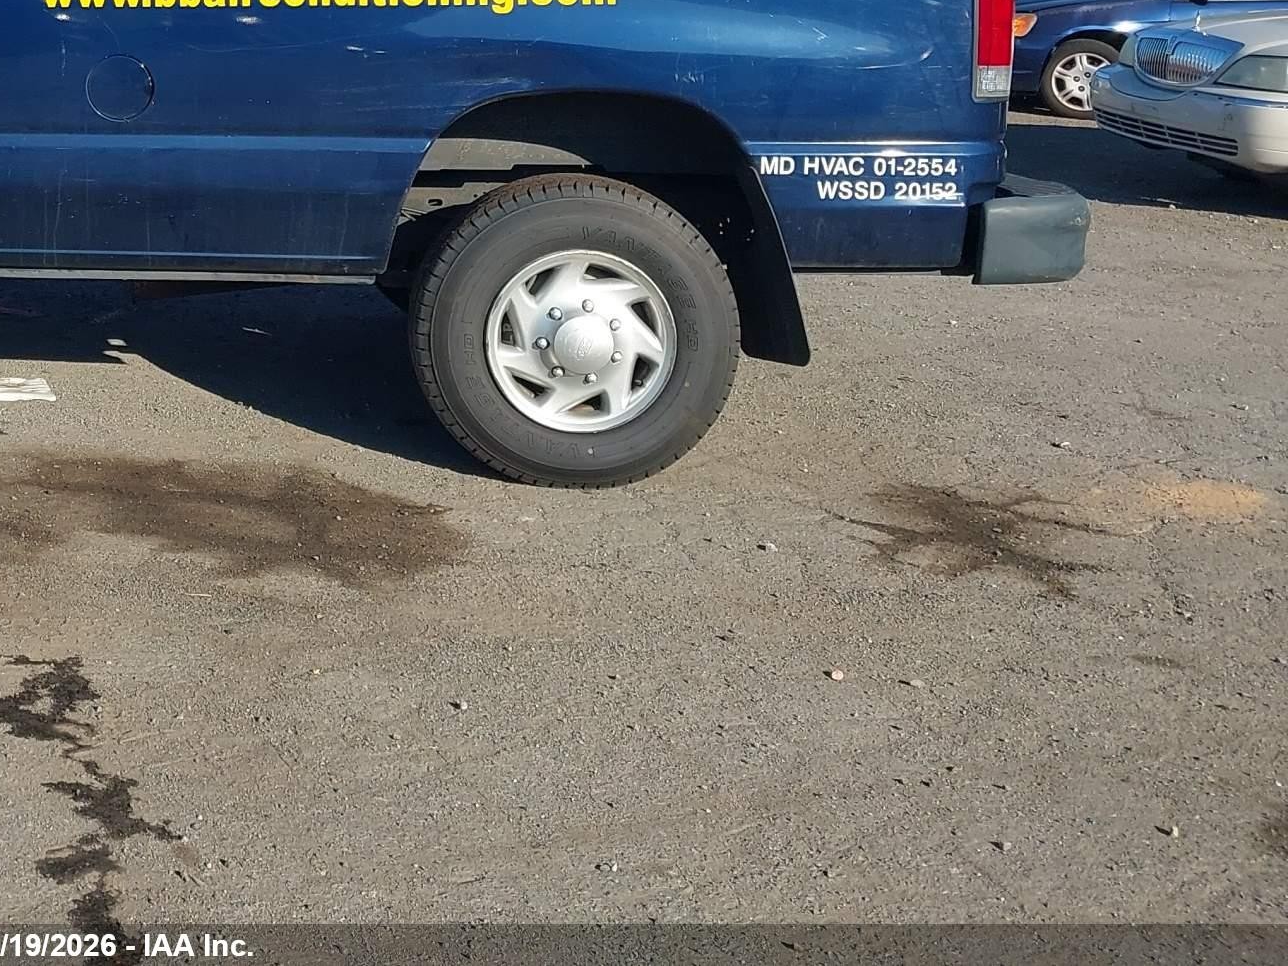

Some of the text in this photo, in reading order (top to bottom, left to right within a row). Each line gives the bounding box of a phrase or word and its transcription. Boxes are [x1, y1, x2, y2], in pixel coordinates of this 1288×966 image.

[760, 156, 957, 176] MD HVAC 01-2554
[817, 180, 958, 201] WSSD 20152
